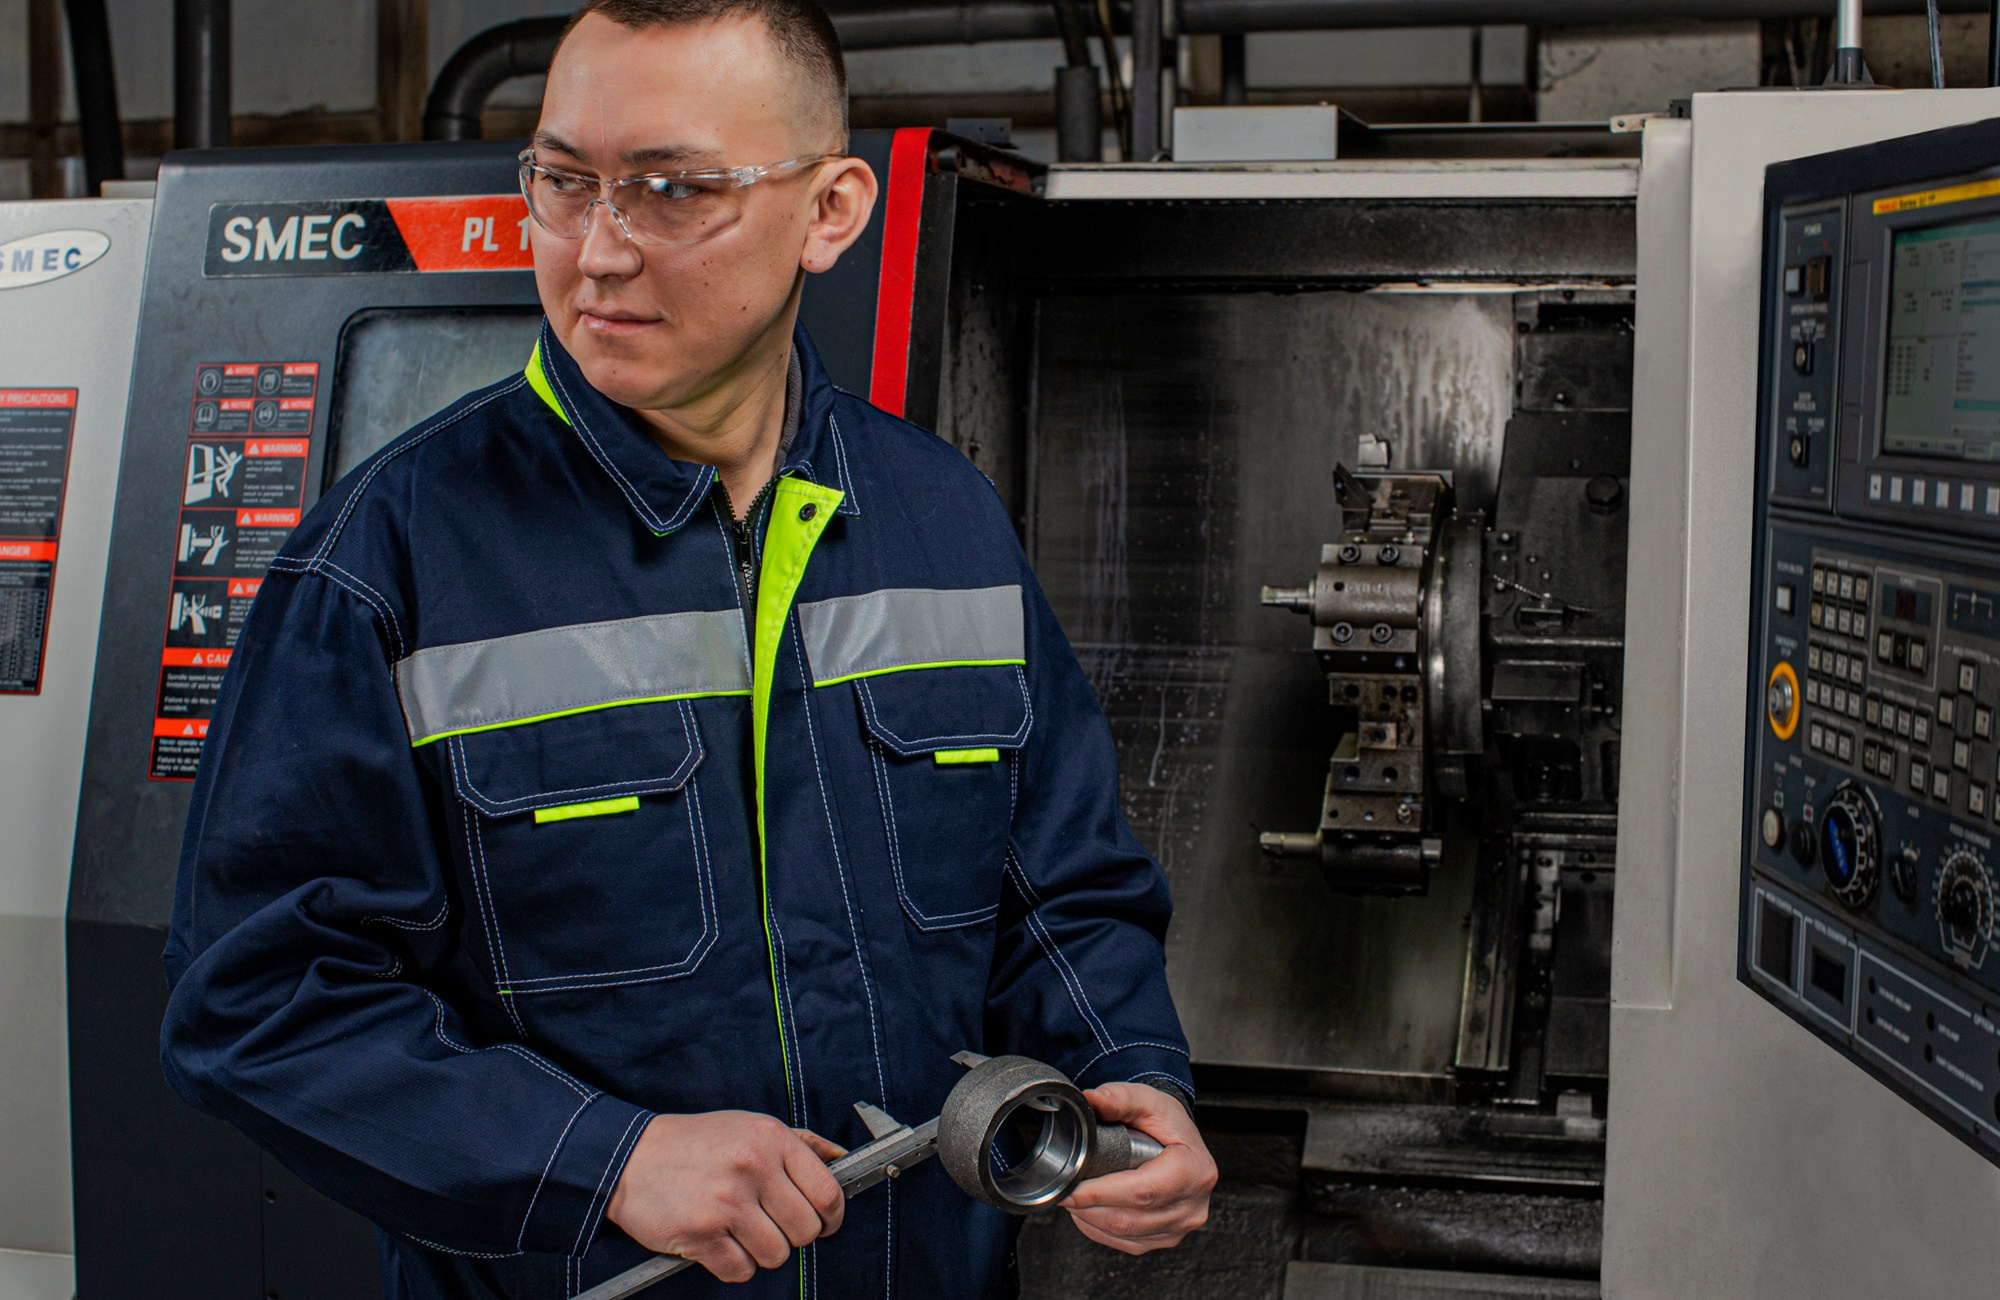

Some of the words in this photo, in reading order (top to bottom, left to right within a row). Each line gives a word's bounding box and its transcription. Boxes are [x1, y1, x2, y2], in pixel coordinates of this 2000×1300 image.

[221, 213, 366, 262] SMEC
[462, 216, 499, 252] PL
[0, 247, 82, 272] MEC
[262, 443, 302, 453] WARNING
[254, 513, 295, 523] WARNING
